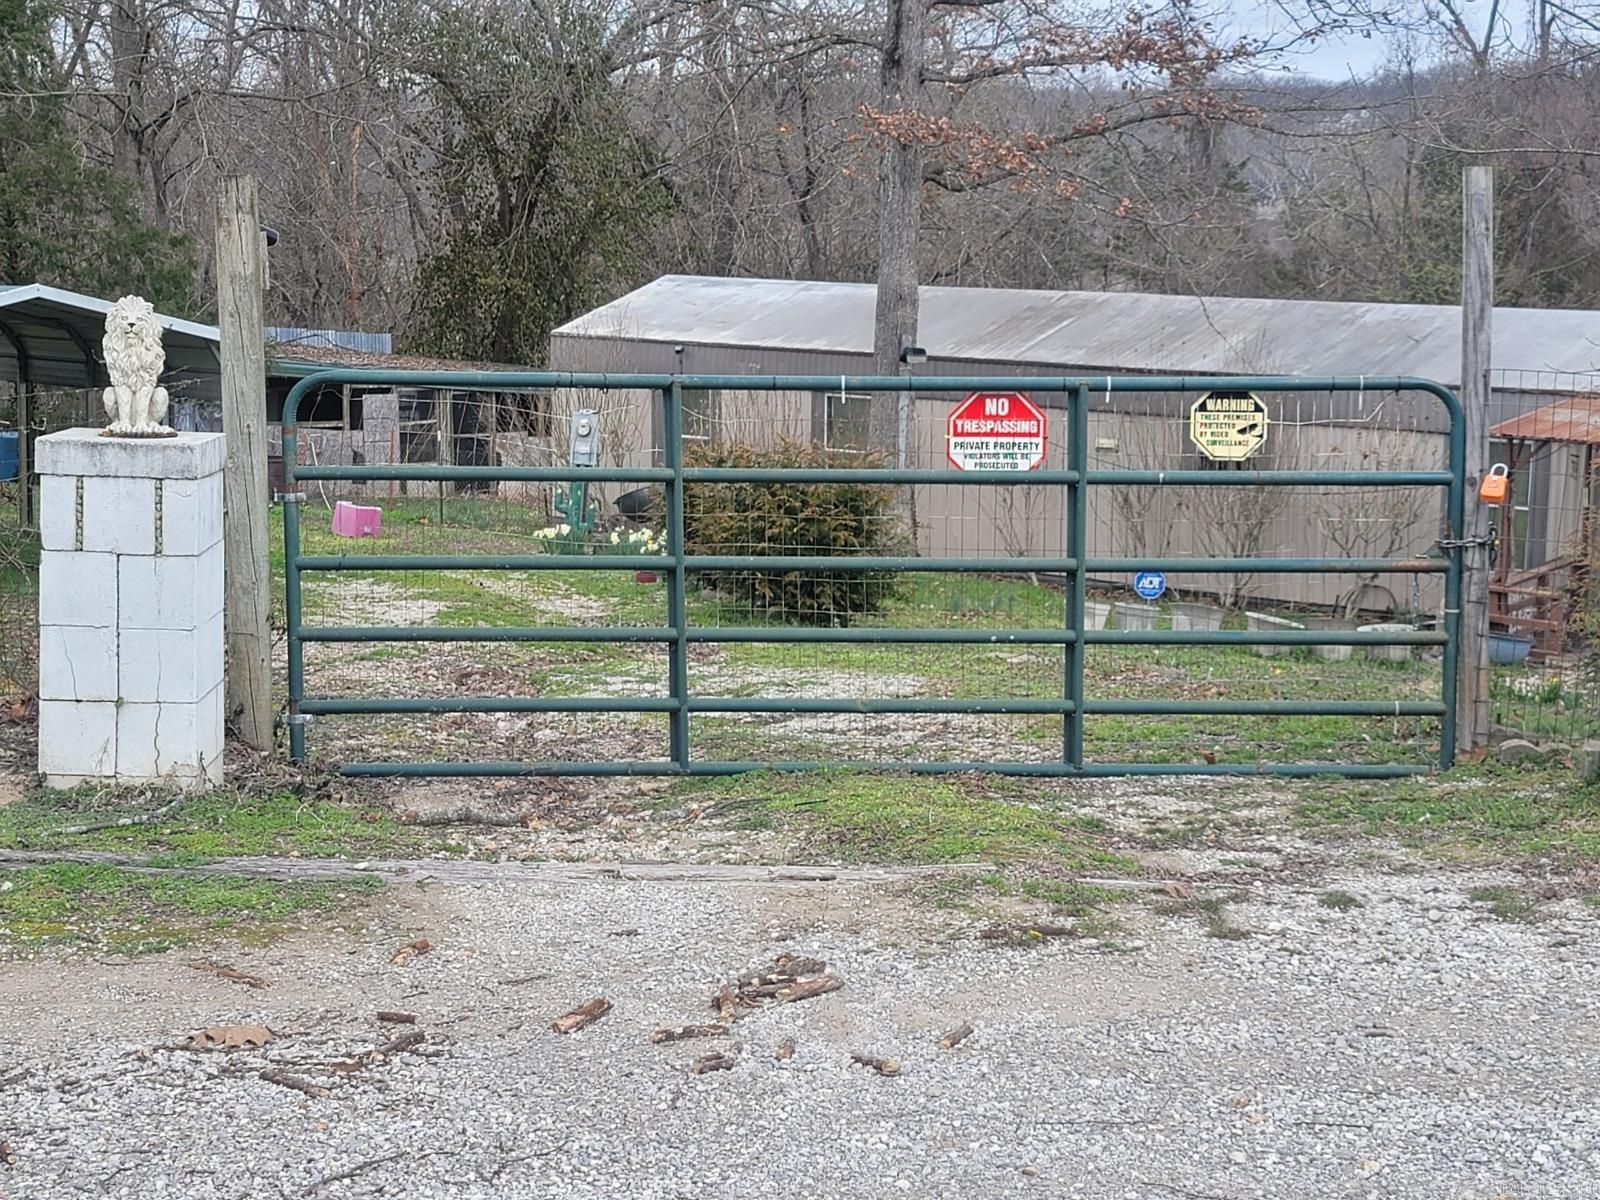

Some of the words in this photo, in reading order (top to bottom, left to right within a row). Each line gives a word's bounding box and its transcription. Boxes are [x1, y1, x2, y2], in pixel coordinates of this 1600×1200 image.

[985, 398, 1009, 416] NO
[1206, 398, 1255, 411] WARNING
[955, 420, 1038, 433] TRESPASSING
[954, 441, 990, 451] PRIVATE
[993, 441, 1040, 451] PROPERTY
[1138, 576, 1163, 589] ADT
